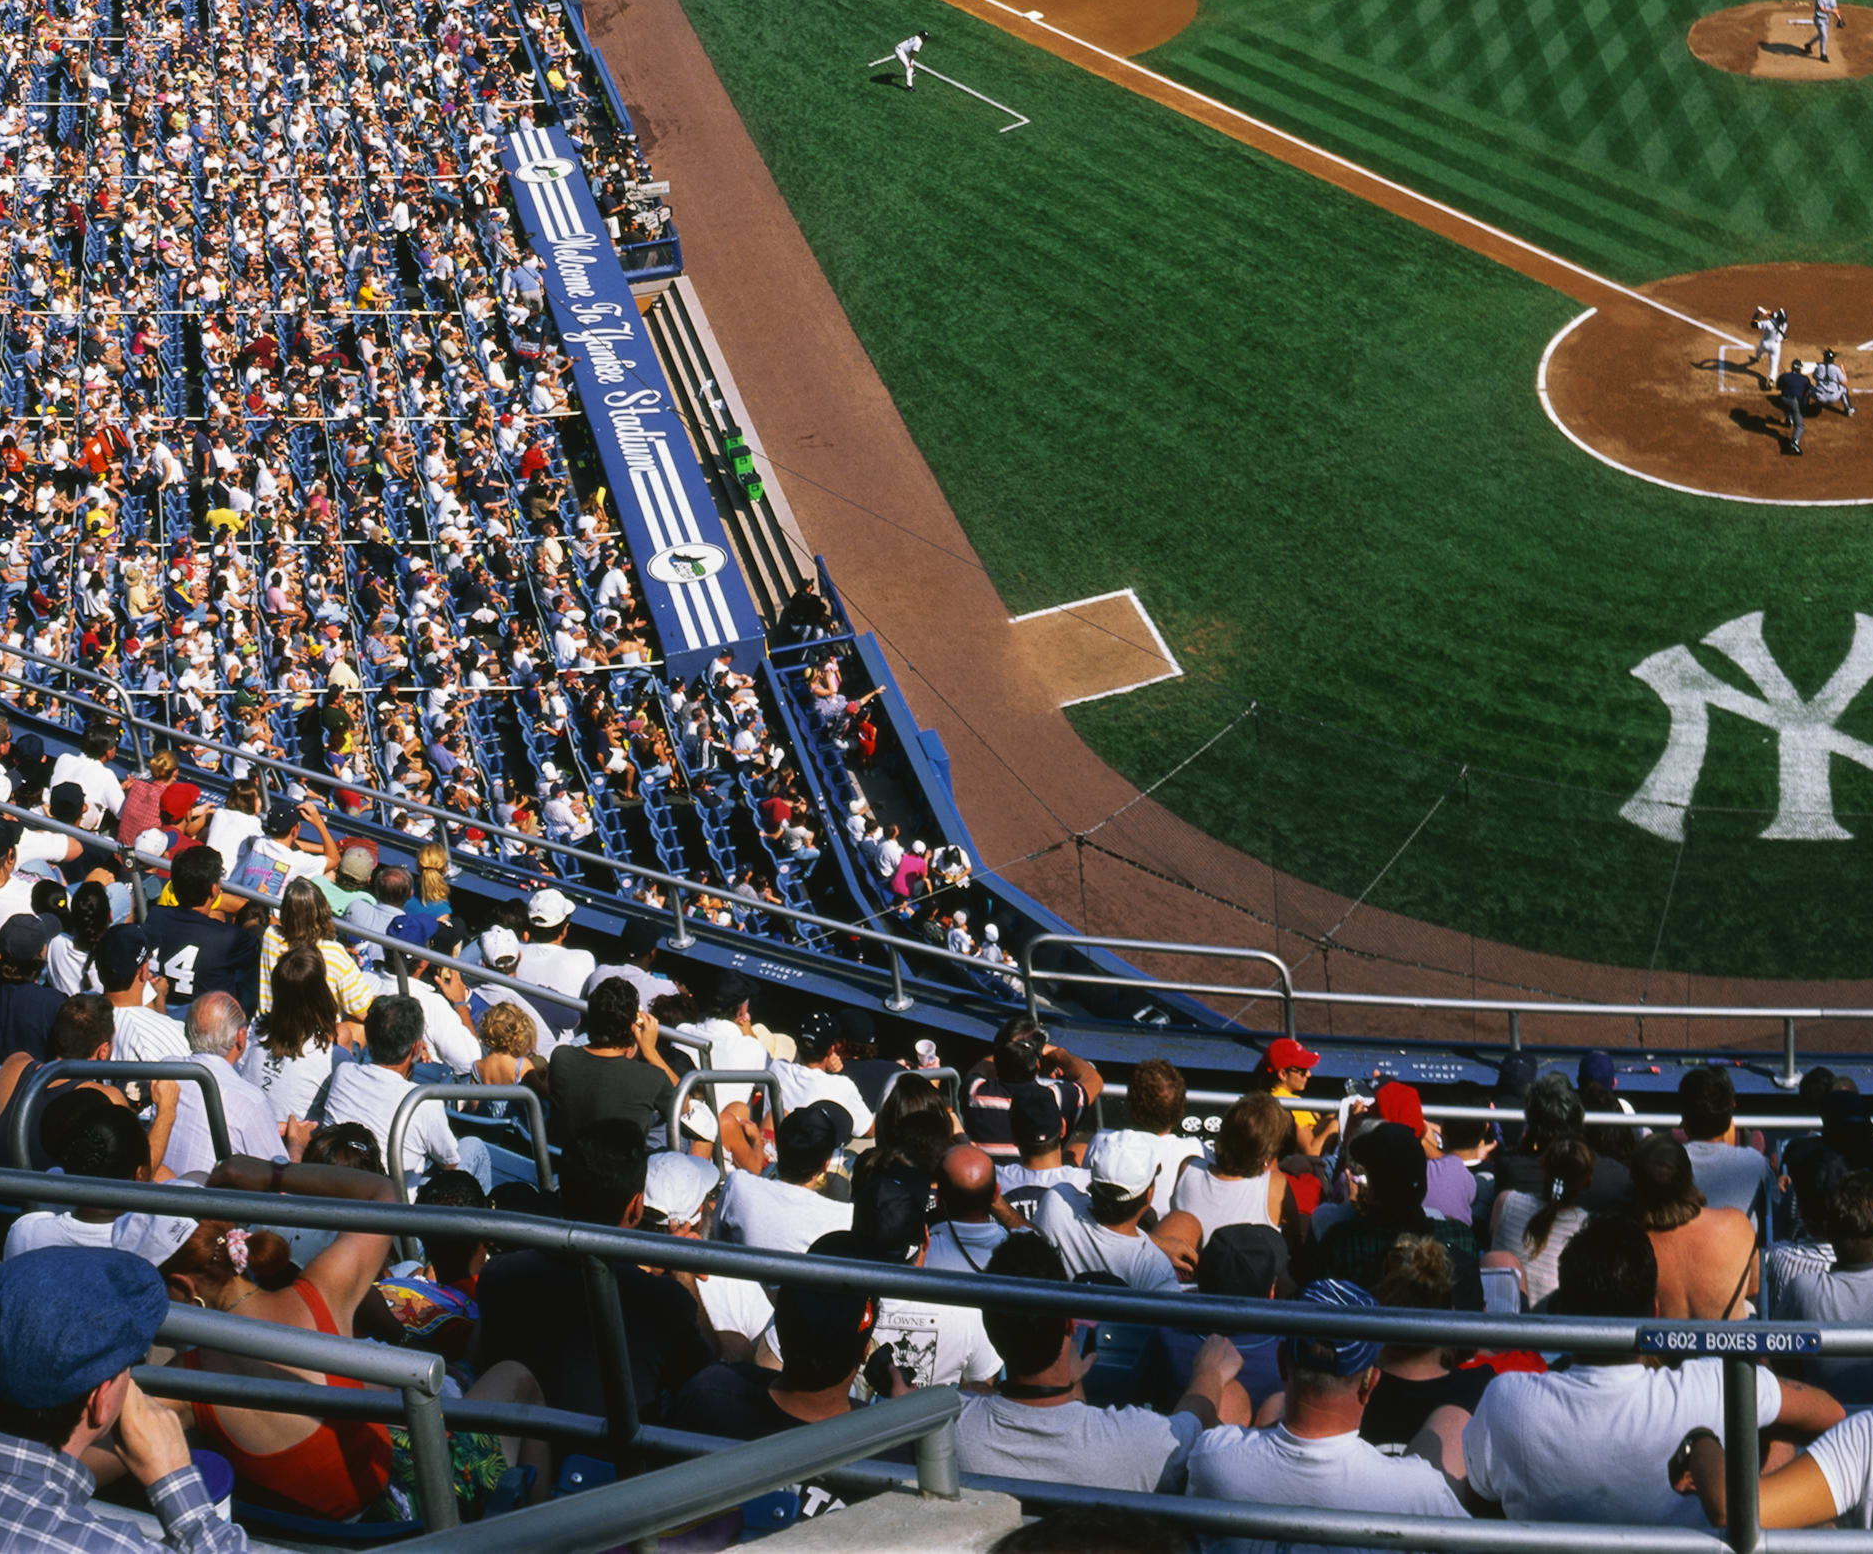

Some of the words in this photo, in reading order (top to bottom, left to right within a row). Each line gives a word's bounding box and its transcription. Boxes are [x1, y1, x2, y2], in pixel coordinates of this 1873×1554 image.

[555, 232, 597, 299] Welcome
[570, 301, 622, 326] To
[562, 321, 635, 386] Yankee
[603, 388, 667, 474] Stadium
[886, 1313, 926, 1328] TOWNE
[1667, 1330, 1698, 1349] 602
[1705, 1332, 1757, 1350] BOXES
[1766, 1333, 1794, 1352] 601
